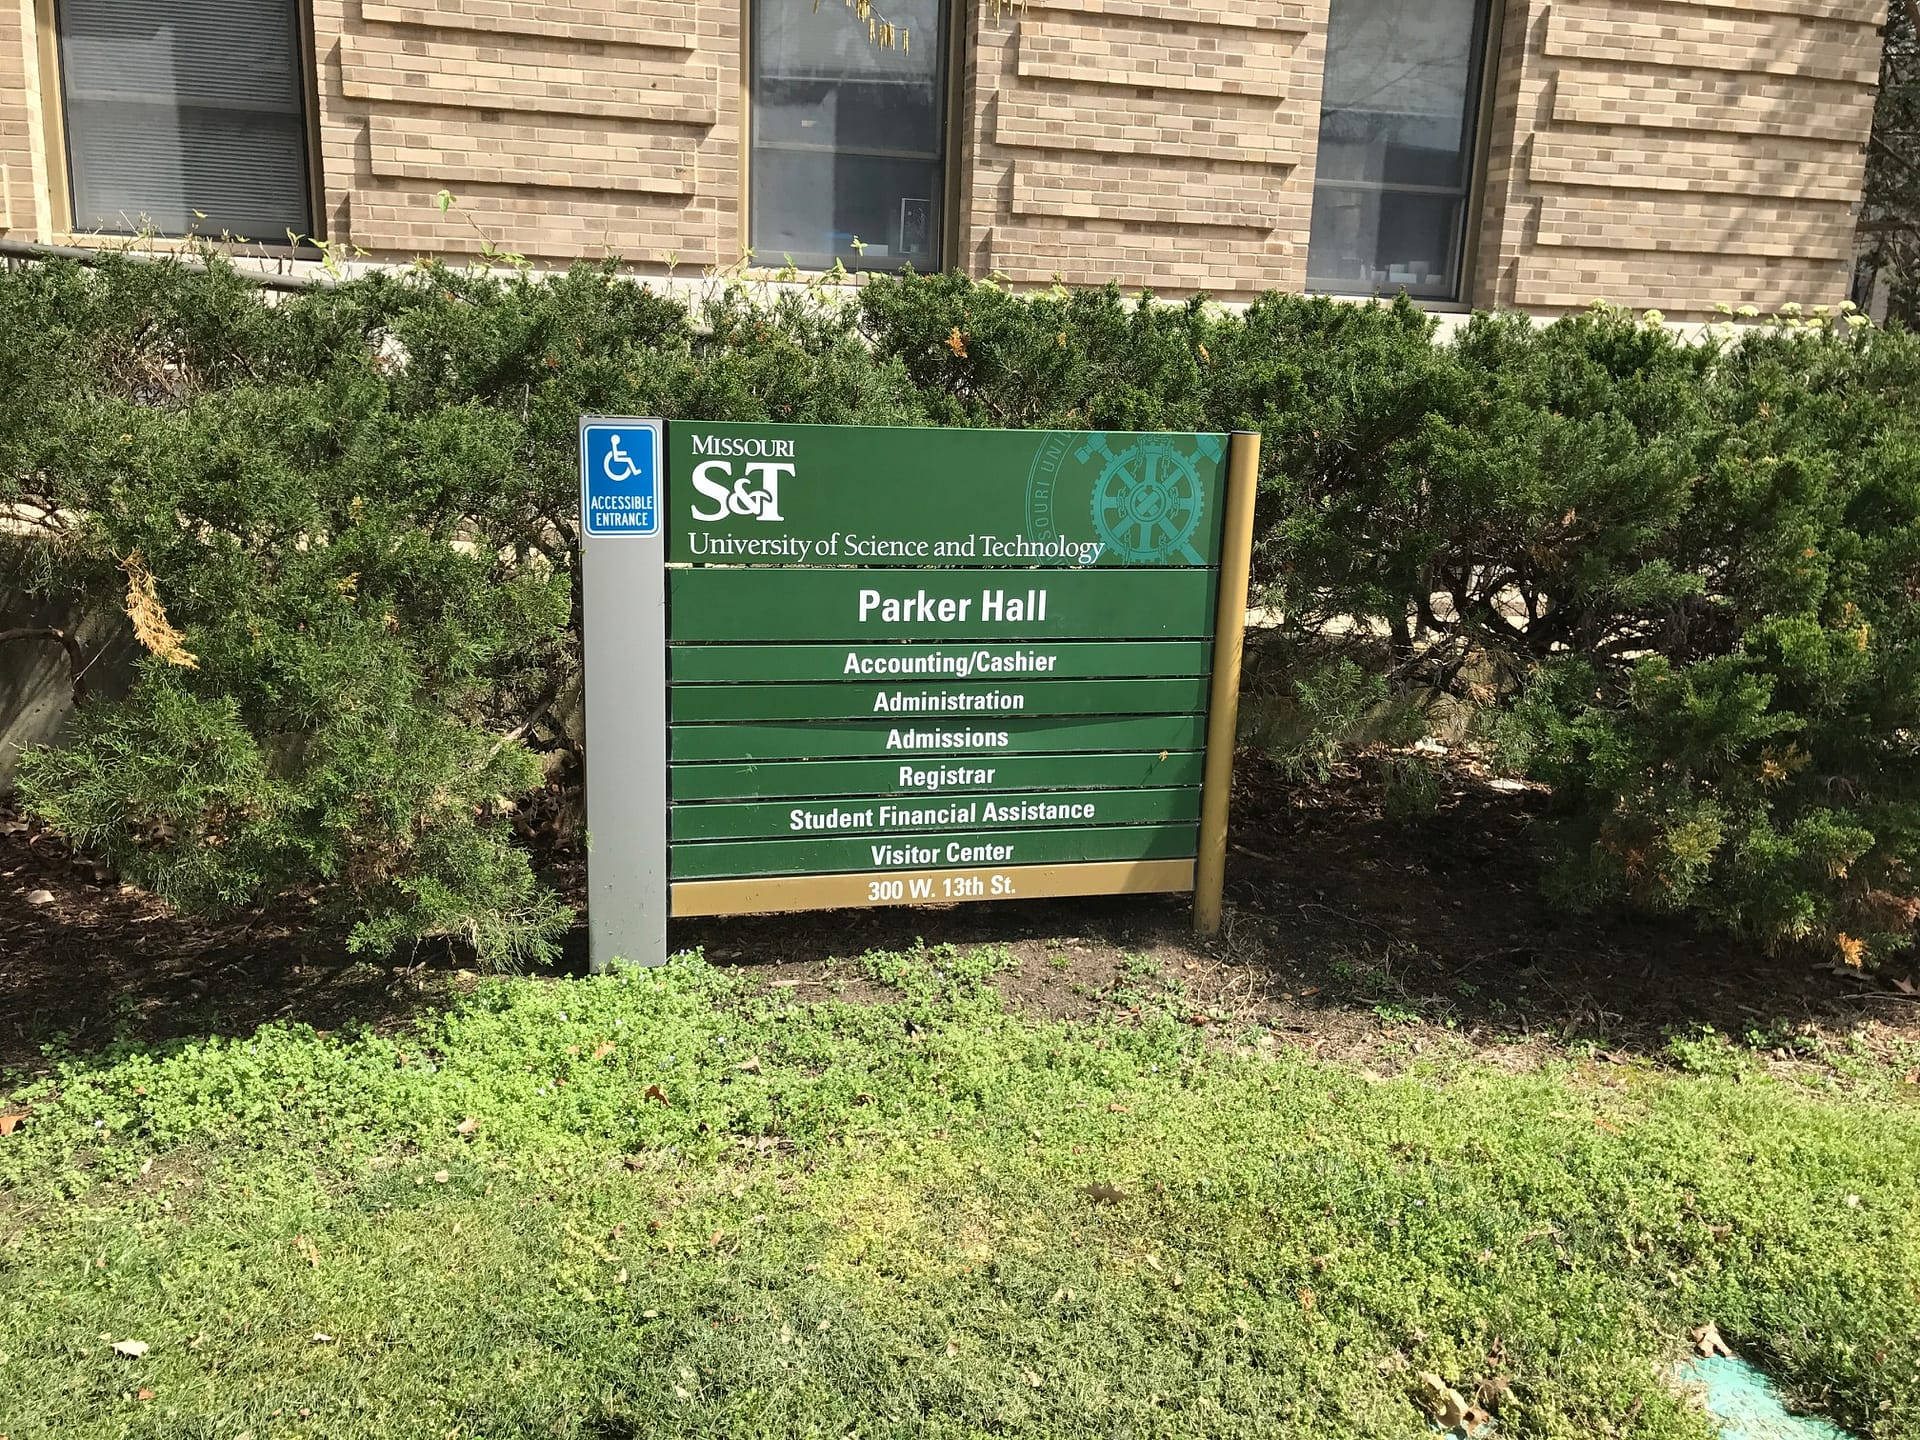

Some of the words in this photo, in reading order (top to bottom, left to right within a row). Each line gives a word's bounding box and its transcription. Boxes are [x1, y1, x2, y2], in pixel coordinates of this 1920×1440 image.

[692, 434, 795, 457] MISSOURI
[591, 495, 653, 510] ACCESSIBLE
[691, 460, 796, 522] S&T
[596, 512, 648, 526] ENTRANCE
[688, 532, 812, 562] University
[815, 532, 841, 556] of
[844, 534, 929, 557] Science
[933, 535, 976, 557] and
[979, 535, 1105, 564] Technology
[859, 590, 972, 622] Parker
[981, 589, 1047, 622] Hall
[843, 651, 1057, 677] Accounting/Cashier
[873, 690, 1024, 712] Administration
[886, 727, 1009, 749] Admissions
[899, 765, 995, 790] Registrar
[789, 808, 873, 831] Student
[879, 803, 976, 827] Financial
[982, 801, 1095, 822] Assistance
[871, 844, 940, 866] Visitor
[946, 843, 1014, 862] Center
[868, 881, 903, 901] 300
[908, 879, 936, 898] W.
[943, 877, 984, 897] 13th
[990, 875, 1016, 894] St.
